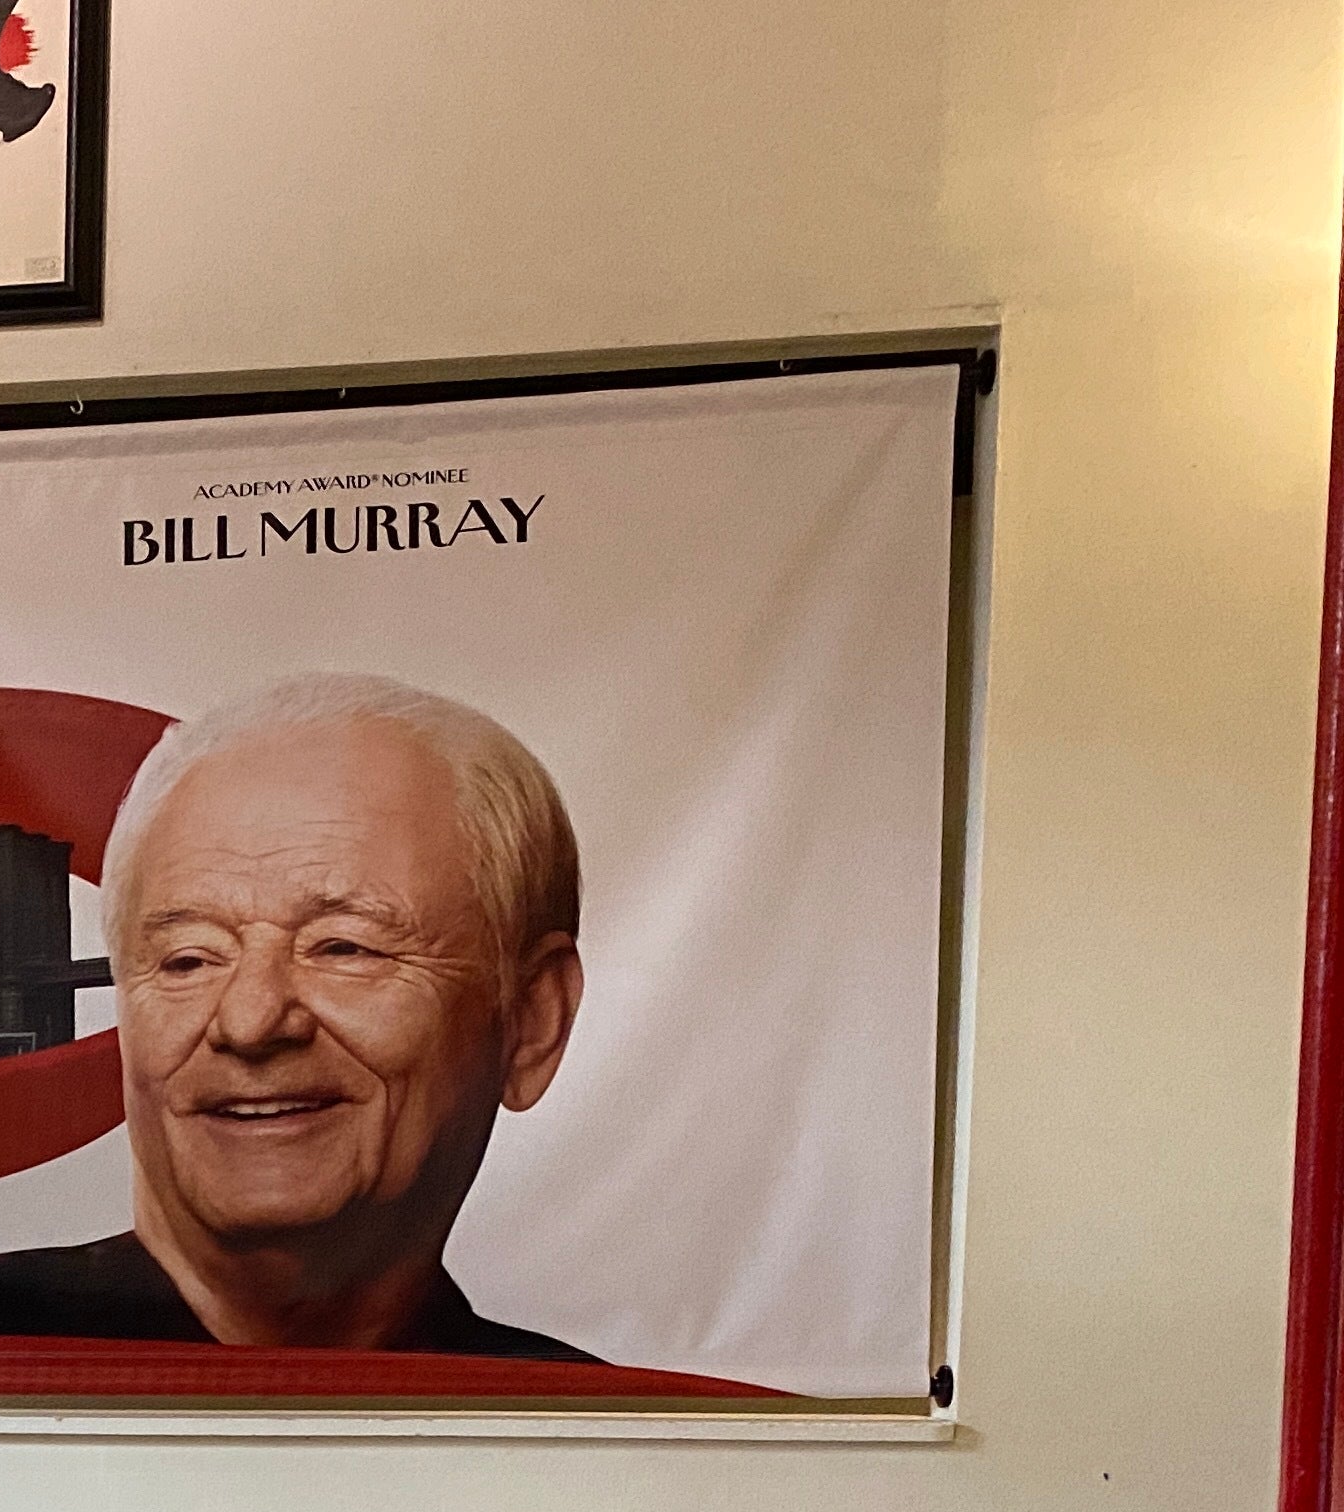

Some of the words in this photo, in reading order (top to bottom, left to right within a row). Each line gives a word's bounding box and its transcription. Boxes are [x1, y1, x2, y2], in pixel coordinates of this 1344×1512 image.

[193, 480, 293, 501] ACADEMY
[382, 468, 469, 488] NOMINEE
[122, 514, 248, 567] BILL
[260, 494, 546, 558] MURRAY
